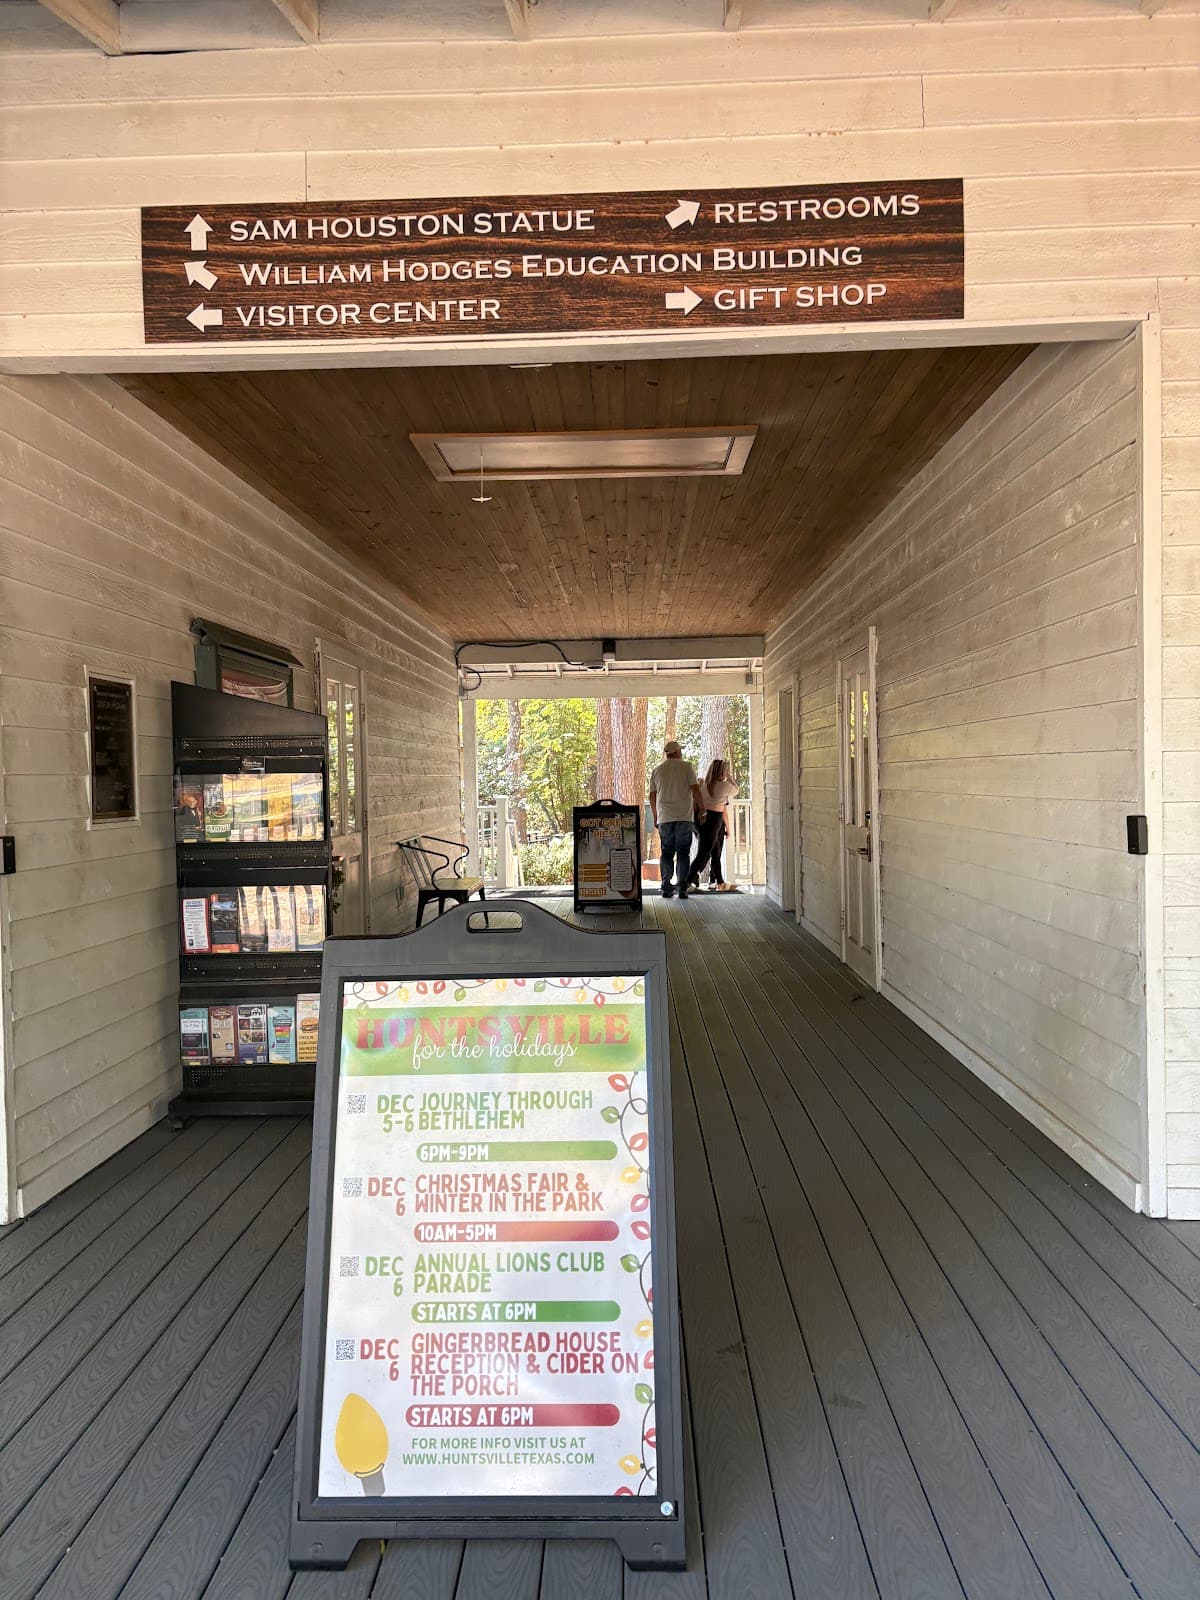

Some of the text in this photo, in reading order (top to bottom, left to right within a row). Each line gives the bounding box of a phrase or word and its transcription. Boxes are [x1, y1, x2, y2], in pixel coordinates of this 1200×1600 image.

[714, 194, 921, 224] RESTROOMS
[229, 208, 596, 242] SAM HOUSTON STATUE
[713, 283, 888, 311] GIFT SHOP
[236, 299, 501, 327] VISITOR CENTER
[355, 1014, 631, 1049] HUNTSVILLE
[412, 1032, 577, 1070] for the holidays
[377, 1089, 593, 1115] DEC JOURNEY THROUGH
[382, 1110, 525, 1133] 5-6 BETHLEHEM
[420, 1143, 489, 1162] 6PM-9PM
[368, 1172, 590, 1197] DEC CHRISTMAS FAIR &
[396, 1191, 605, 1217] 6 WINTER IN THE PARK
[418, 1223, 497, 1242] 10AM-5PM
[365, 1251, 606, 1277] DEC ANNUAL LIONS CLUB
[393, 1273, 492, 1297] 6 PARADE
[416, 1302, 537, 1321] STARTS AT 6PM
[360, 1331, 621, 1360] DEC GINGERBREAD HOUSE
[389, 1352, 639, 1382] 6 RECEPTION & CIDER ON
[410, 1375, 519, 1396] THE PORCH
[411, 1406, 534, 1426] STARTS AT 6PM
[411, 1437, 586, 1450] FOR MORE INFO VISIT US AT
[402, 1452, 595, 1466] WWW.HUNTSVILLETEXAS.COM
